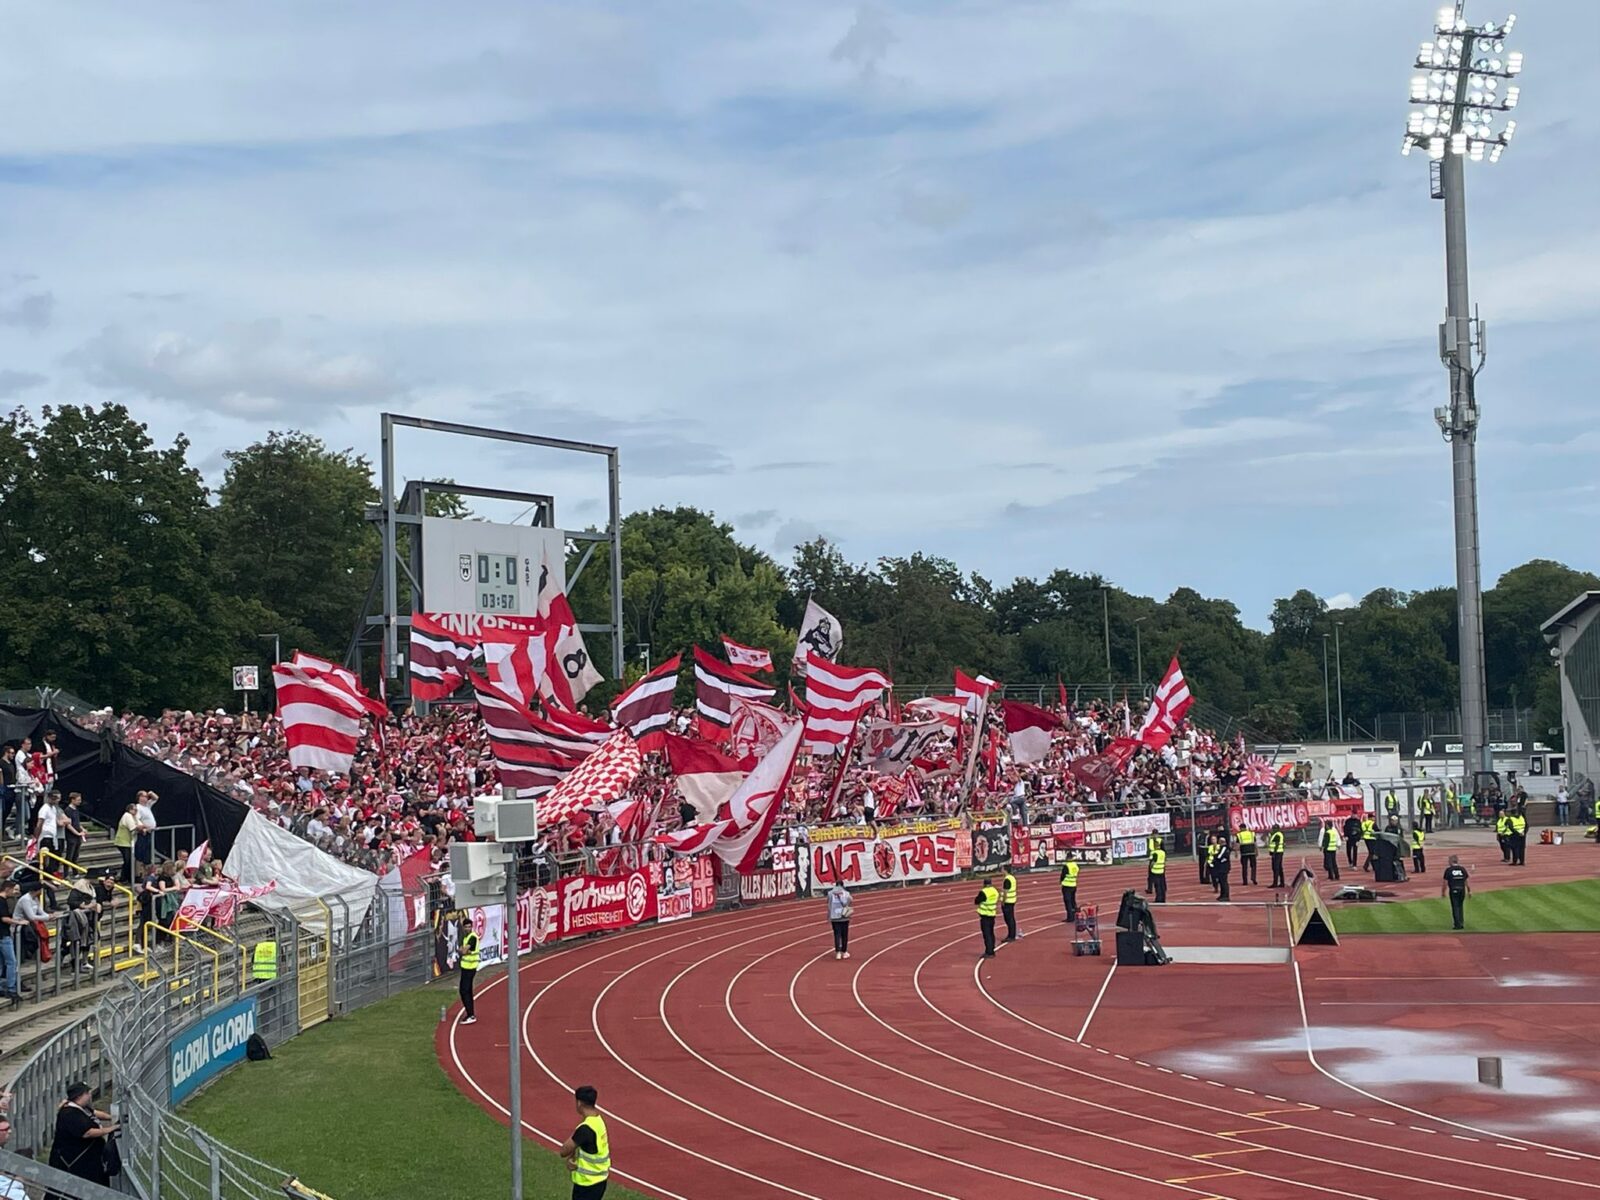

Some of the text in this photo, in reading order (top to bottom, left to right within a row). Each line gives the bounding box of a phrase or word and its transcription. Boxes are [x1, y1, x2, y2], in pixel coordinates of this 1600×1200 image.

[482, 593, 514, 609] 03:57
[1242, 803, 1297, 830] RATINGEN
[741, 874, 761, 900] ALLES
[761, 872, 777, 899] AUS
[777, 869, 797, 897] LIEBE
[563, 878, 626, 933] Fortuna
